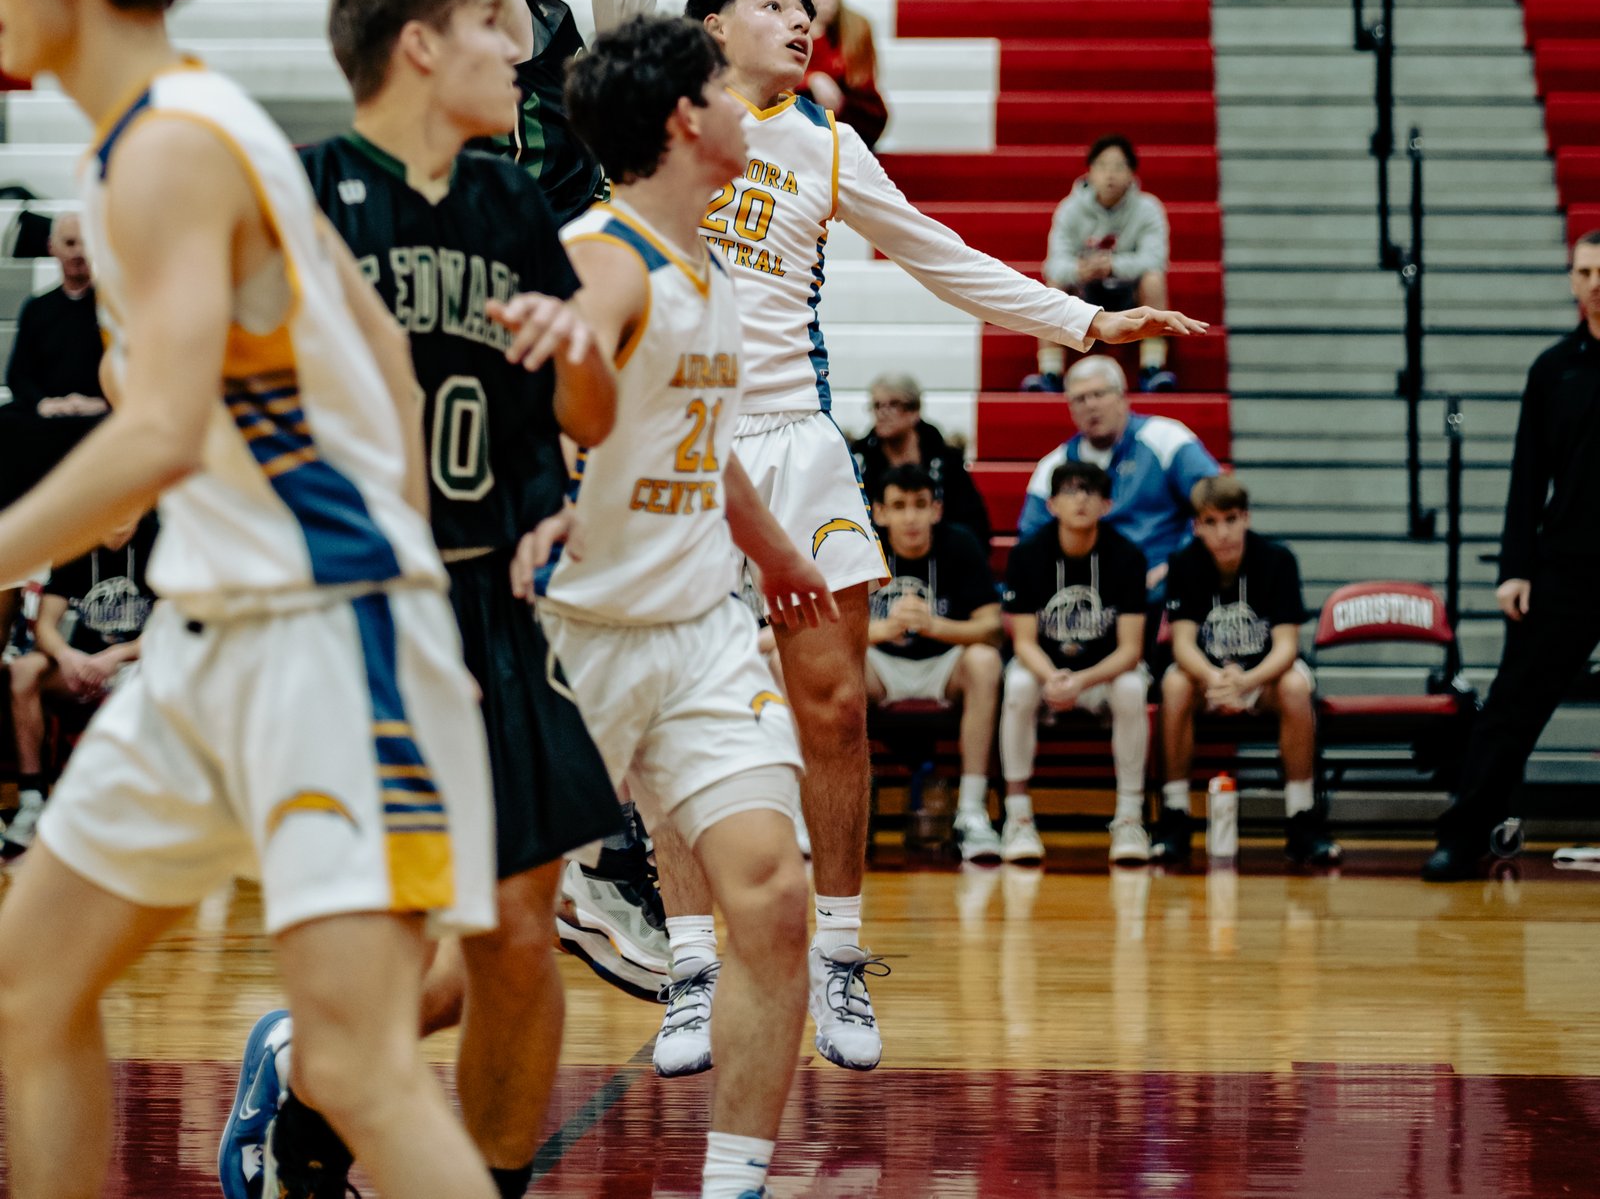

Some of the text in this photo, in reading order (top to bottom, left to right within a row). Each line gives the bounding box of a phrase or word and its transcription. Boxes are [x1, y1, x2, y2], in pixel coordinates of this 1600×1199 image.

[699, 179, 776, 242] 20
[741, 159, 798, 195] ORA
[389, 246, 519, 351] EDWAR
[431, 375, 495, 501] 0
[673, 398, 724, 473] 21
[1332, 592, 1434, 633] CHRISTIAN
